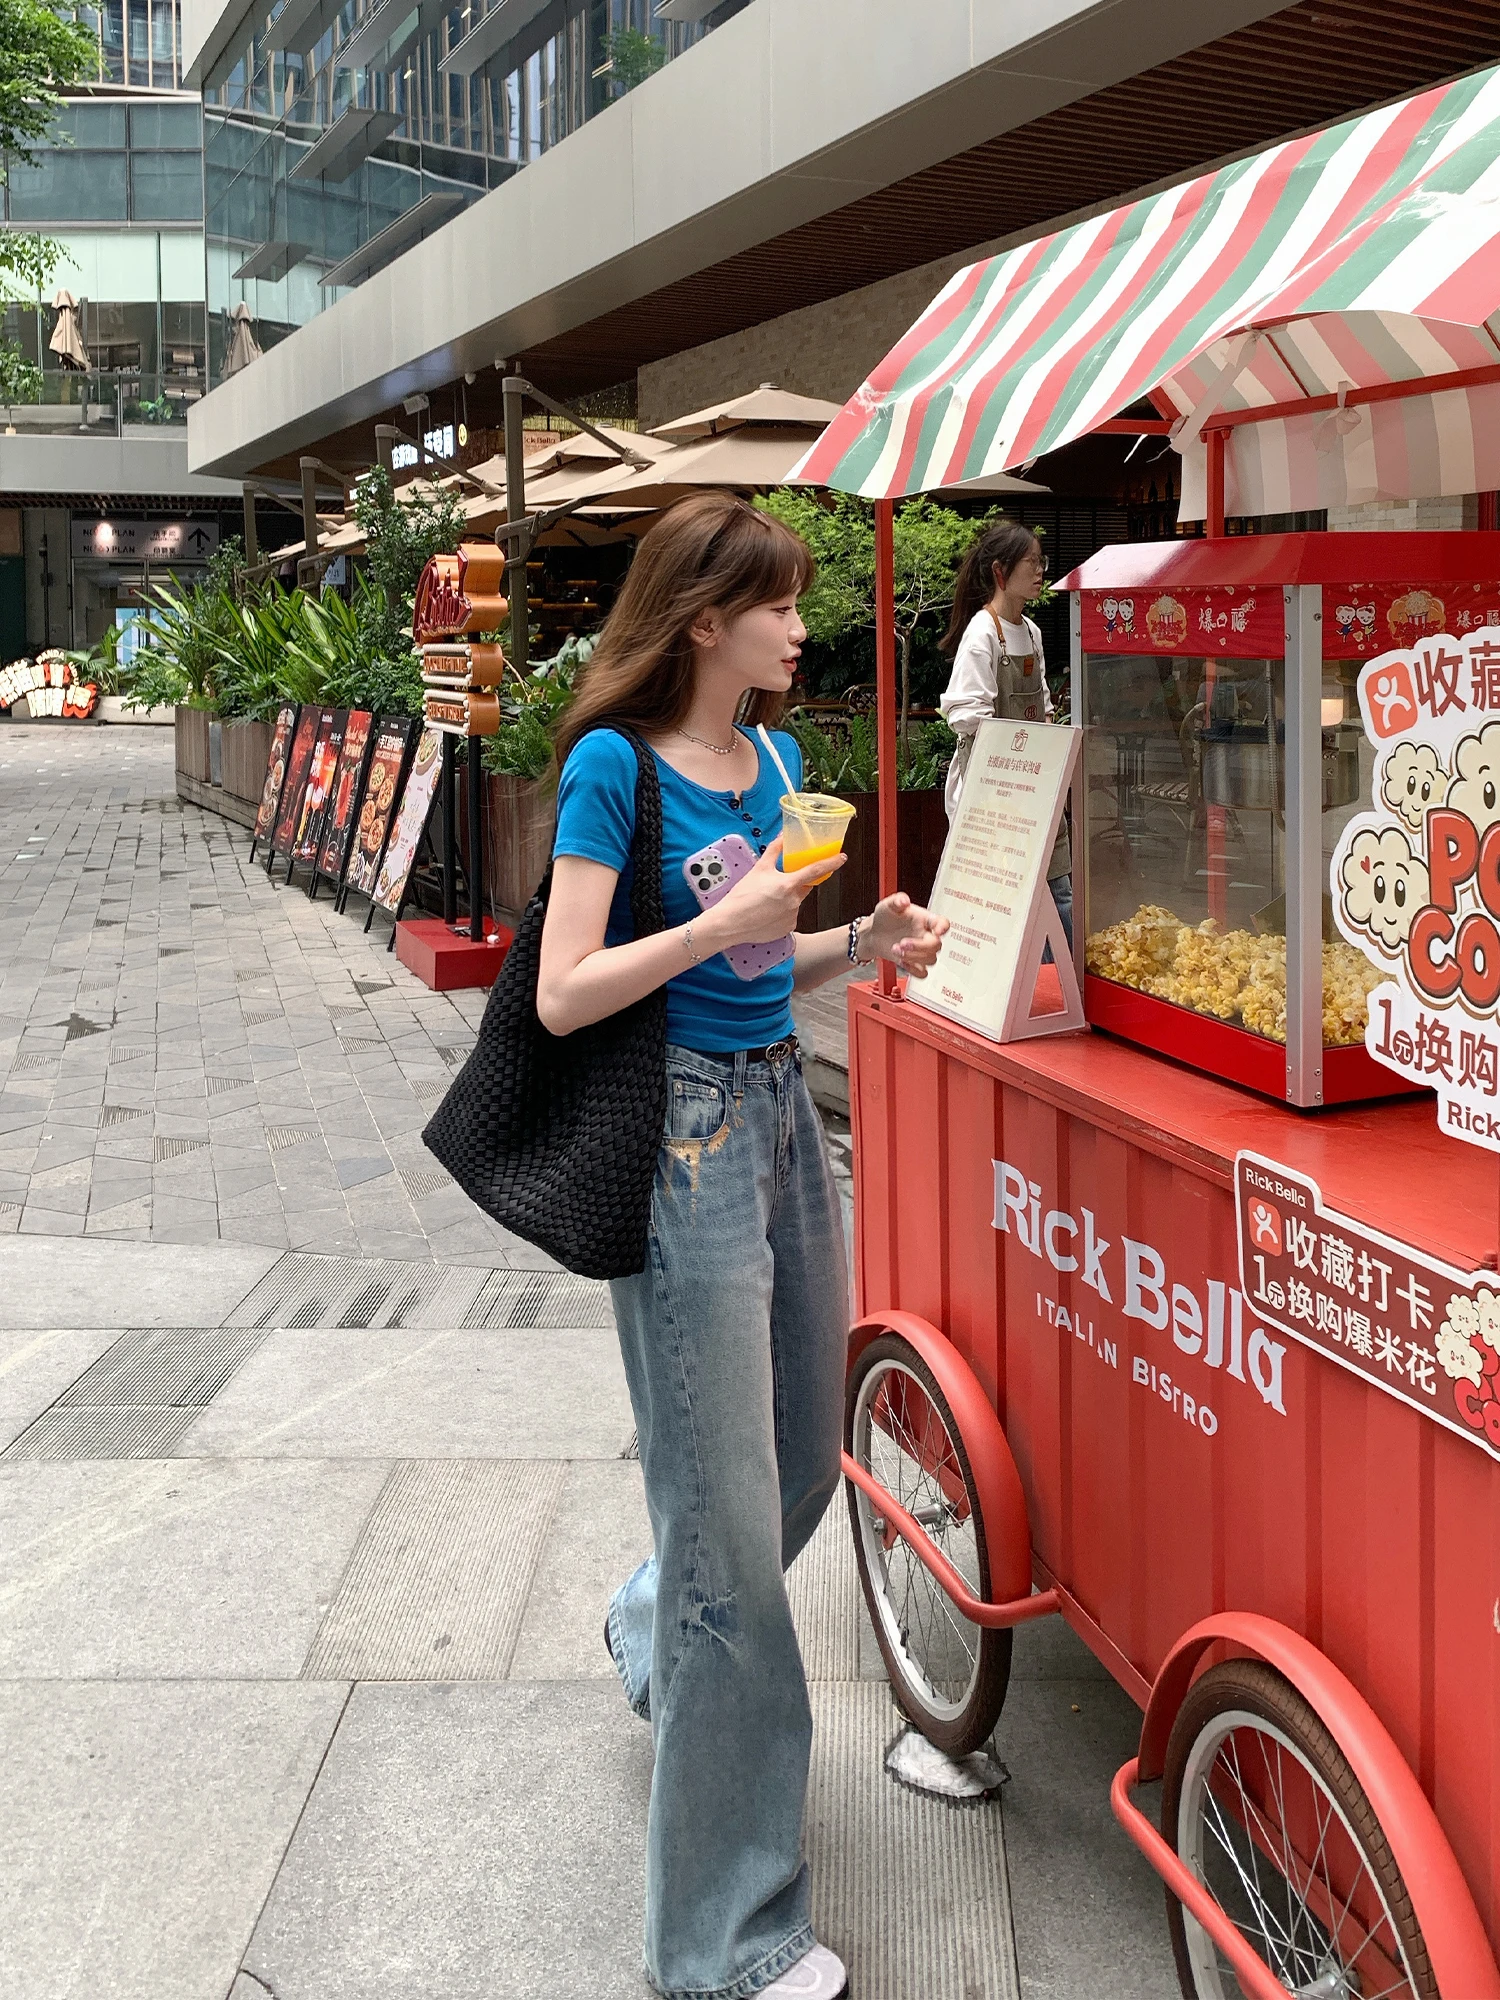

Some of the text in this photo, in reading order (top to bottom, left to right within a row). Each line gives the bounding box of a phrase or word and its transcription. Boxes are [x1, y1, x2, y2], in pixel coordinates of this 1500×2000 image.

[112, 546, 135, 554] PLAN
[1447, 1100, 1500, 1141] Rick
[1245, 1167, 1307, 1208] Rick Bella
[991, 1158, 1287, 1416] Rick Bella
[1285, 1216, 1435, 1330] 收藏打卡
[1253, 1255, 1437, 1396] 1元换购爆米花
[1132, 1356, 1218, 1436] BISTRO
